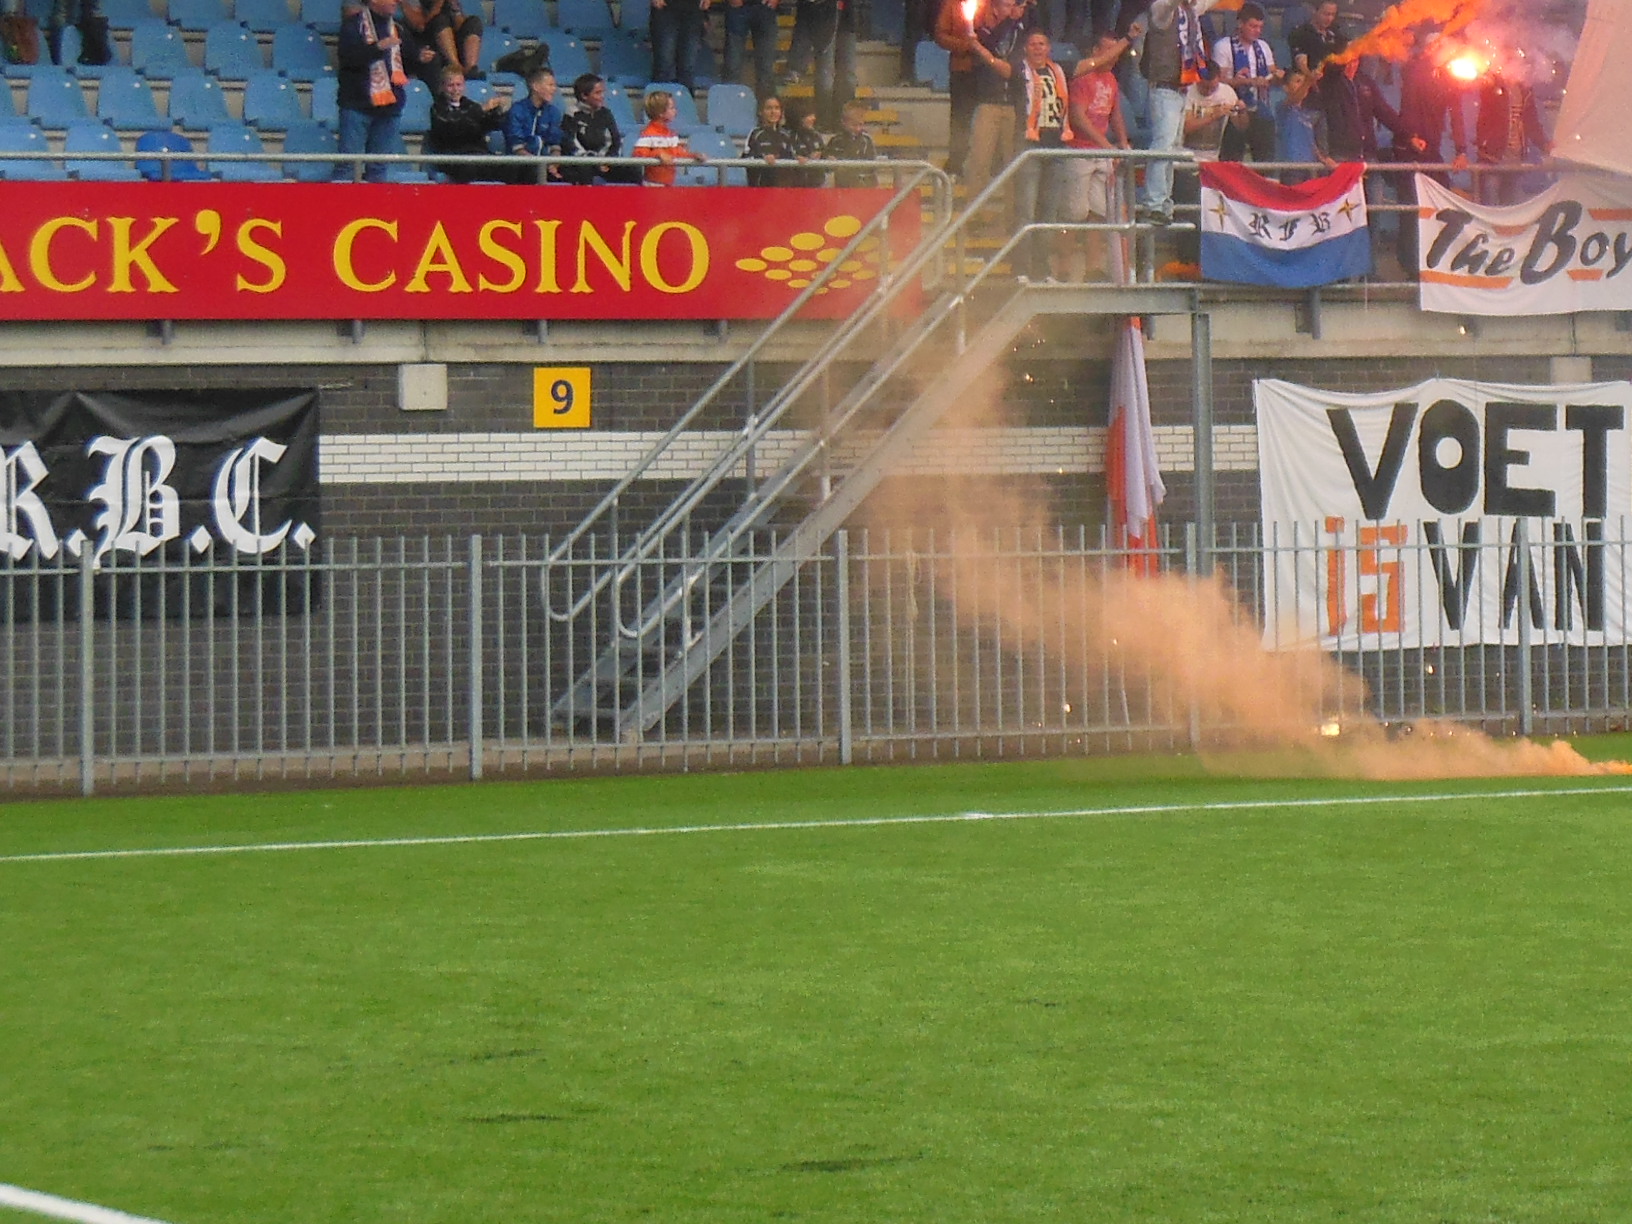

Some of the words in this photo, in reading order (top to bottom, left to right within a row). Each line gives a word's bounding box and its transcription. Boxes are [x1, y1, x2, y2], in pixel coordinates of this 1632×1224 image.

[333, 217, 710, 294] CASINO
[1426, 208, 1515, 277] The
[550, 379, 574, 415] 9
[1423, 518, 1604, 631] VAN
